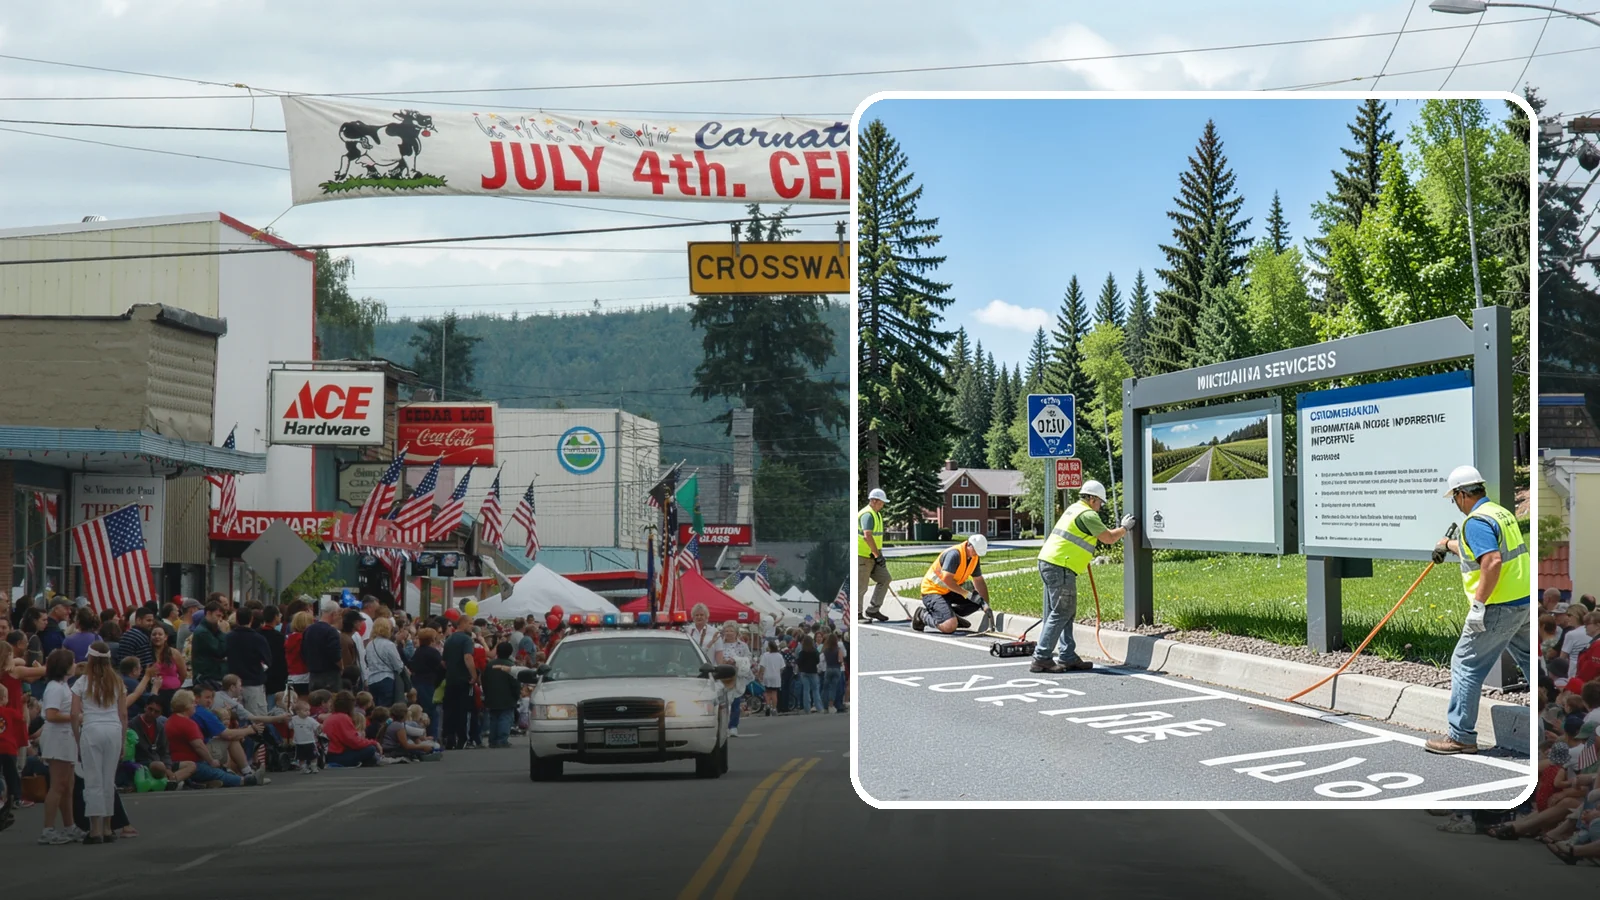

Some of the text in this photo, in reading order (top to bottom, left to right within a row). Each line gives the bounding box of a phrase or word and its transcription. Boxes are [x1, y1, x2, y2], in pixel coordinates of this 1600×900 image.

[481, 141, 604, 193] JULY
[632, 150, 746, 198] 4th.
[697, 254, 850, 280] CROSSWA
[282, 380, 374, 420] ACE
[405, 409, 485, 422] CEDAR LOG
[283, 421, 371, 437] Hardware
[416, 428, 477, 447] Coca-Cola
[353, 467, 384, 480] Simpl
[95, 485, 124, 495] Vincent
[126, 485, 136, 495] de
[138, 486, 155, 495] Paul
[688, 526, 741, 535] CRNATION
[699, 535, 730, 543] GLASS
